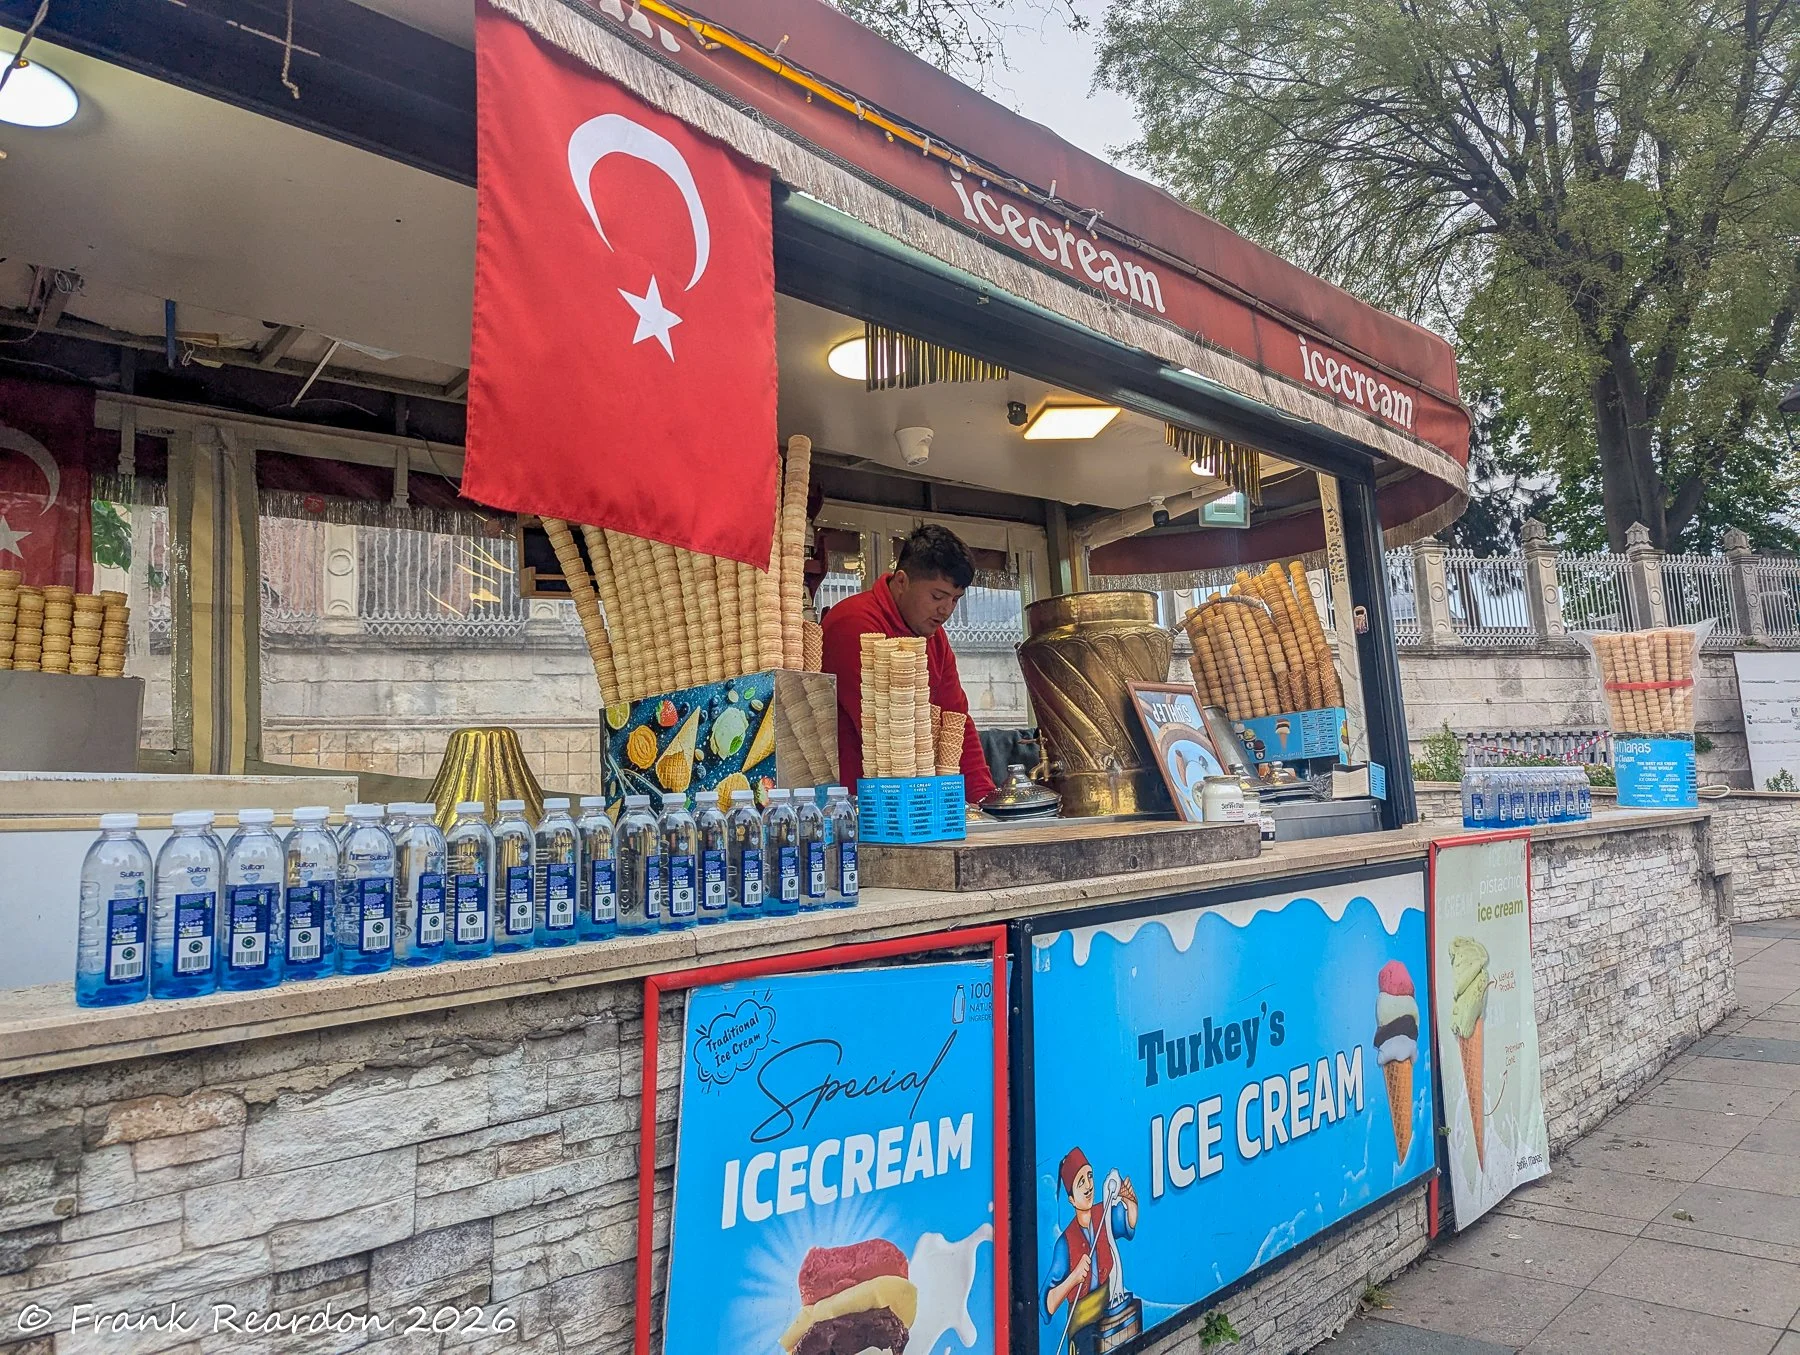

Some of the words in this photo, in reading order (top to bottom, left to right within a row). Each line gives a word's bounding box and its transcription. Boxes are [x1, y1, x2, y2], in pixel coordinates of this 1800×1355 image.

[951, 168, 1165, 312] icecream
[1298, 334, 1412, 429] icecream
[1477, 902, 1492, 922] ice
[1494, 900, 1524, 918] cream
[706, 1012, 759, 1052] Traditional
[732, 1033, 760, 1055] Cream
[1138, 1002, 1286, 1088] Turkey's
[750, 1030, 958, 1143] Special
[1150, 1096, 1224, 1198] ICE
[1236, 1046, 1364, 1160] CREAM
[721, 1113, 974, 1230] ICECREAM
